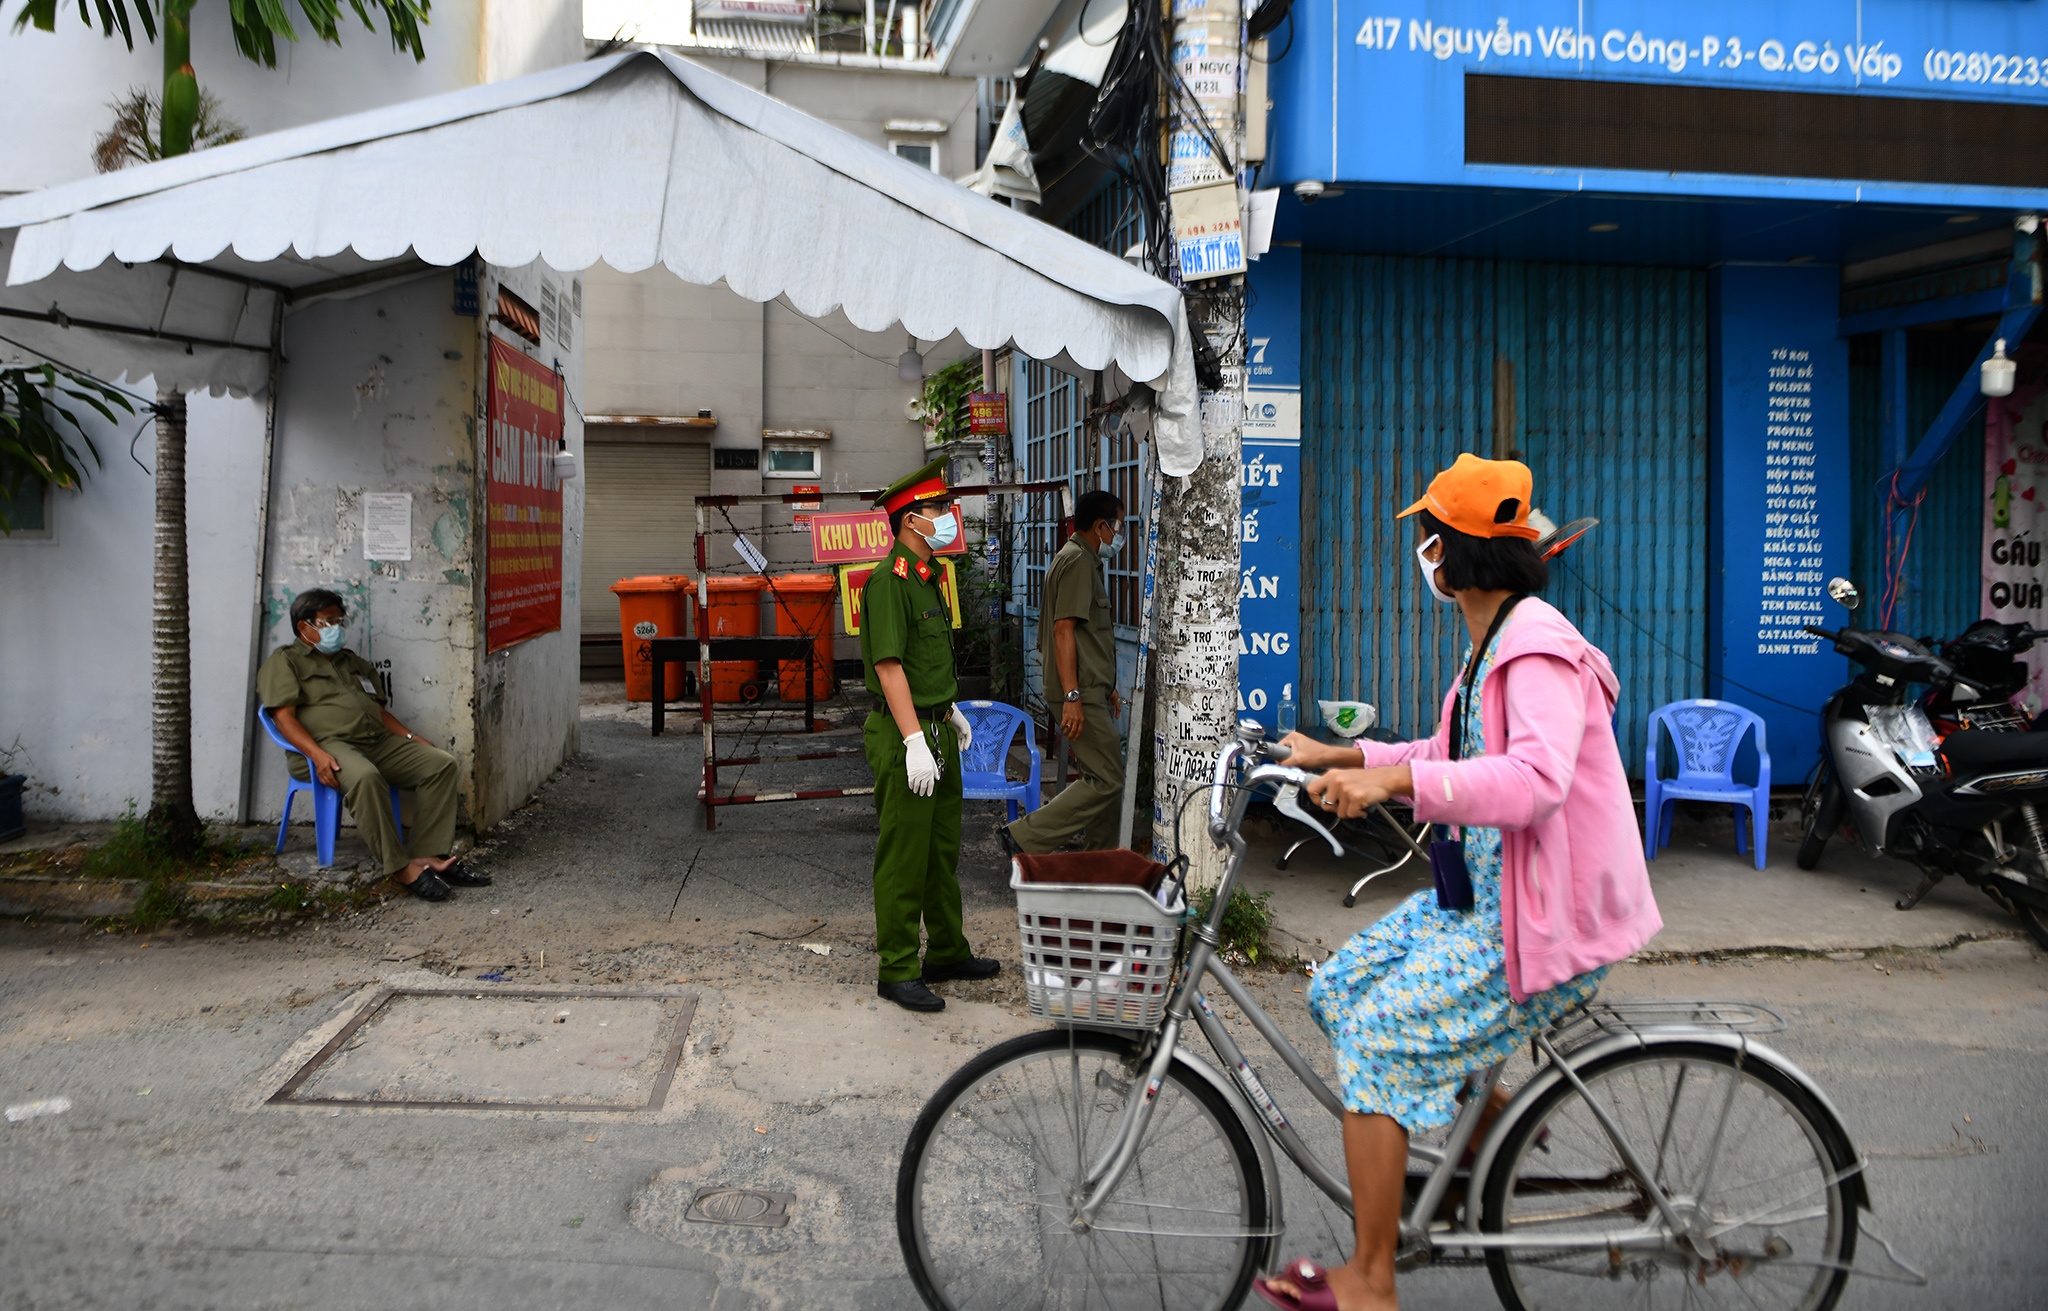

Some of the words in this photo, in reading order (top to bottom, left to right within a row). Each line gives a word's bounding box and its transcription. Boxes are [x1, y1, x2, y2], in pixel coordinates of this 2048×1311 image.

[1355, 17, 1401, 50] 417
[1409, 17, 1532, 61] Nguyễn
[1536, 26, 1596, 60] Văn
[1844, 40, 1903, 84] Vấp
[973, 408, 992, 417] 496
[1766, 440, 1780, 451] IN
[1781, 440, 1814, 452] MENU
[1766, 454, 1790, 466] BAO
[1242, 508, 1259, 542] Ế
[820, 523, 853, 551] KHU
[856, 519, 889, 554] VỰC
[1990, 530, 2041, 567] GẤU
[1763, 556, 1792, 568] MICA
[1799, 557, 1823, 568] ALU
[1237, 566, 1279, 598] ẤN
[1762, 585, 1776, 596] IN
[1807, 585, 1823, 597] LY
[1990, 577, 2043, 609] QUÀ
[1761, 600, 1785, 611] TEM
[1786, 600, 1824, 611] DECAL
[1759, 614, 1774, 625] IN
[636, 626, 656, 634] 5266
[1757, 644, 1790, 654] DANH
